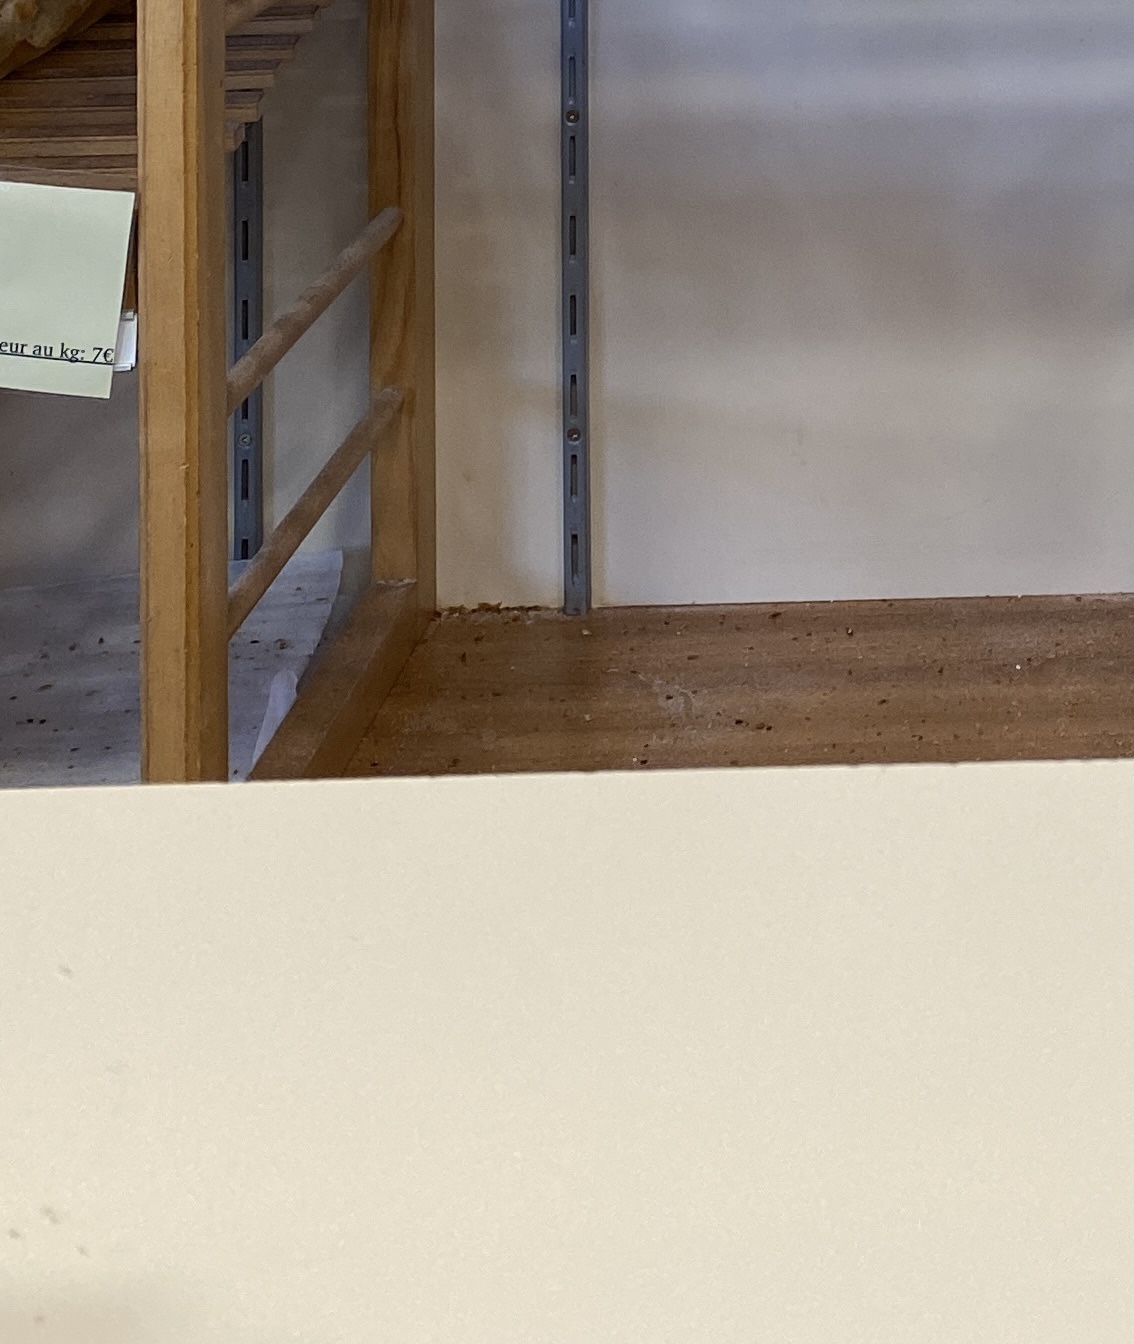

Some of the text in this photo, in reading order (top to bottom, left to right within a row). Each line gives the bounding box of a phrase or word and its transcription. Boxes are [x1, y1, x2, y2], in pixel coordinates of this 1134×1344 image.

[32, 344, 53, 358] au
[60, 342, 86, 363] kg:
[92, 346, 115, 364] 7€
